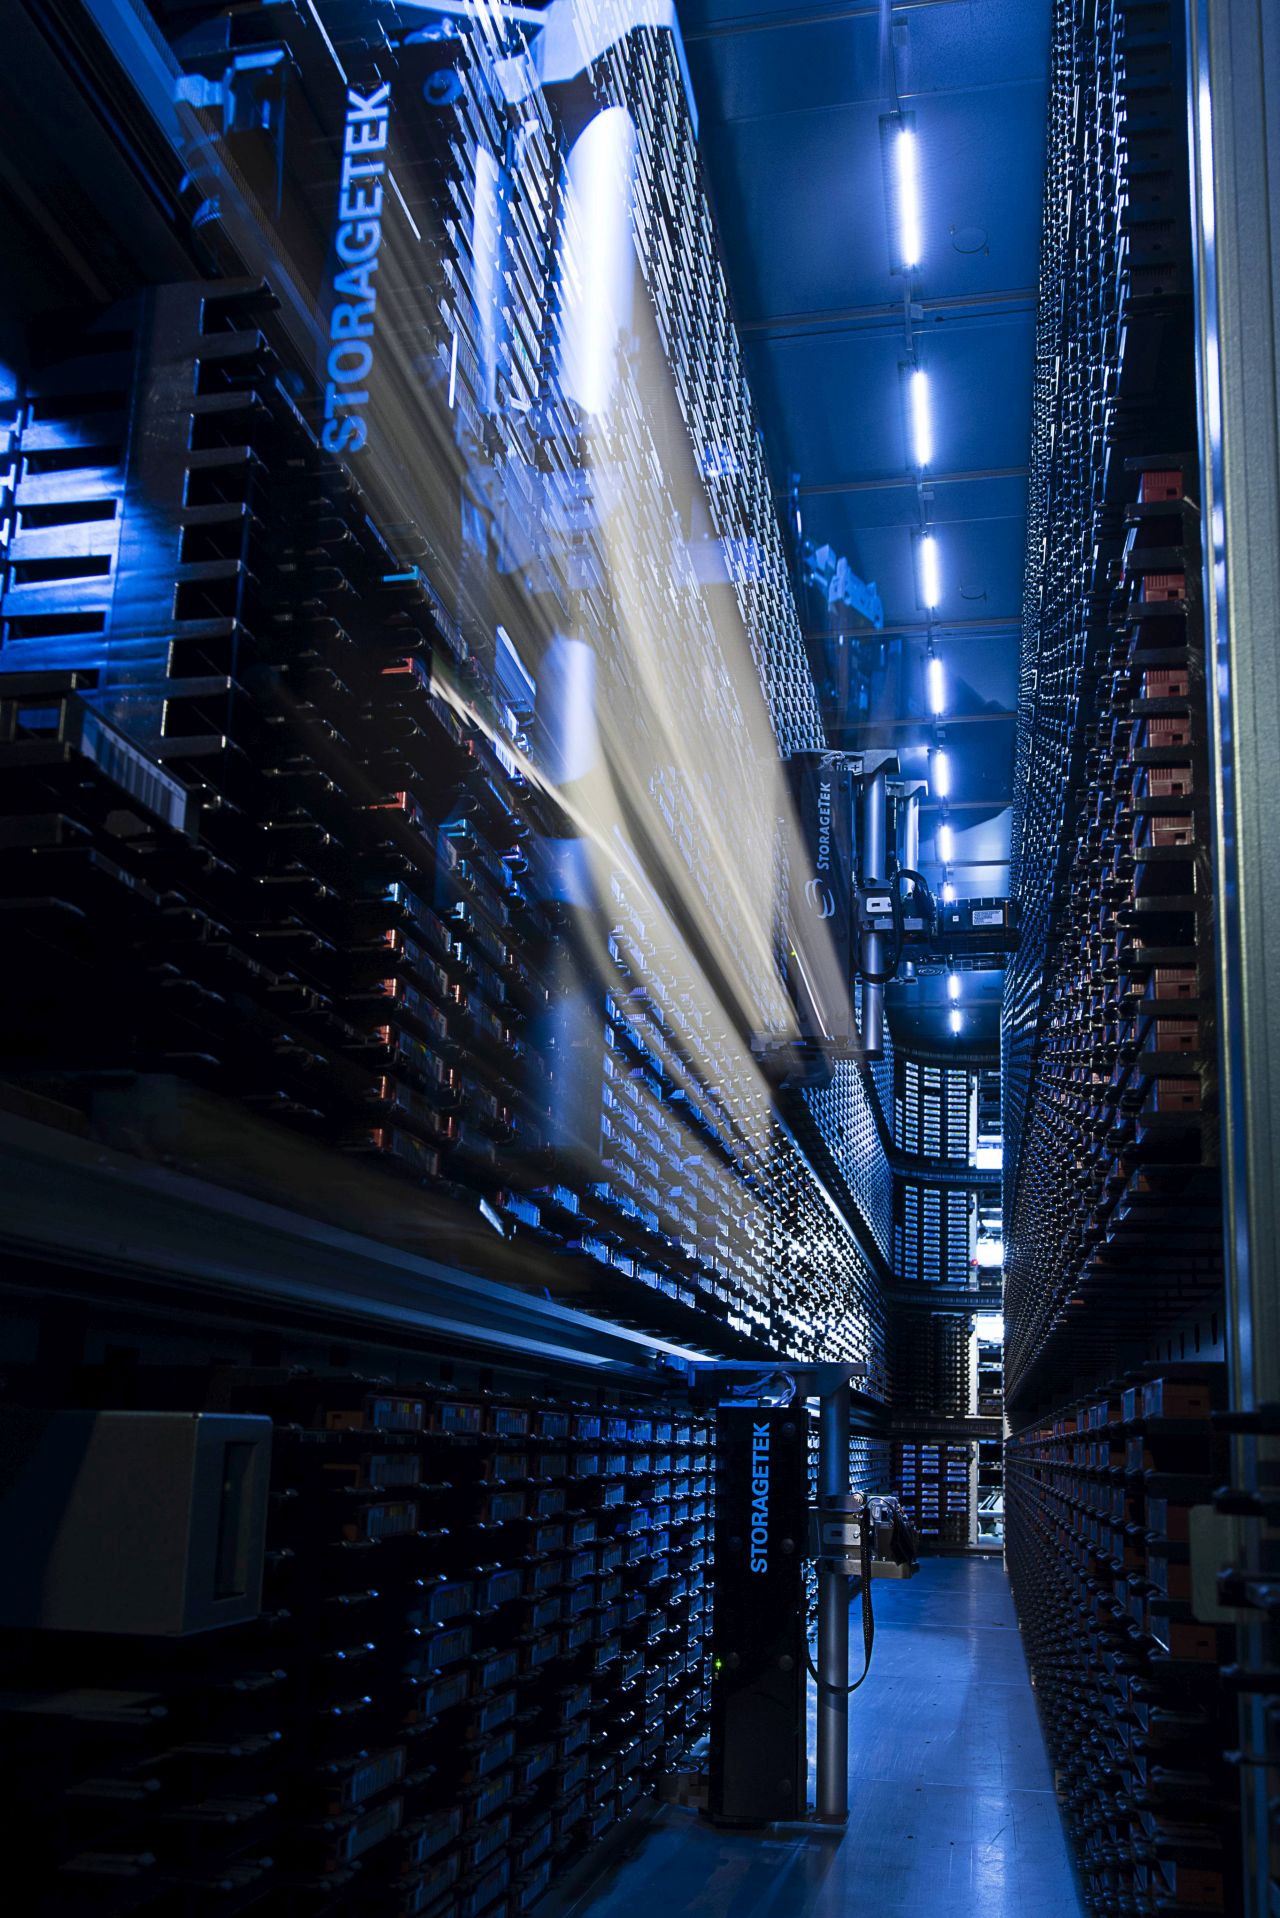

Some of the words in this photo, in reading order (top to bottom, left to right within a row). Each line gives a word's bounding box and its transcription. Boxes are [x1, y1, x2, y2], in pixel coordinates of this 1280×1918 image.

[320, 80, 392, 454] STORAGETEK
[817, 782, 831, 870] STORAGETEK
[750, 1422, 771, 1574] STORAGETEK
